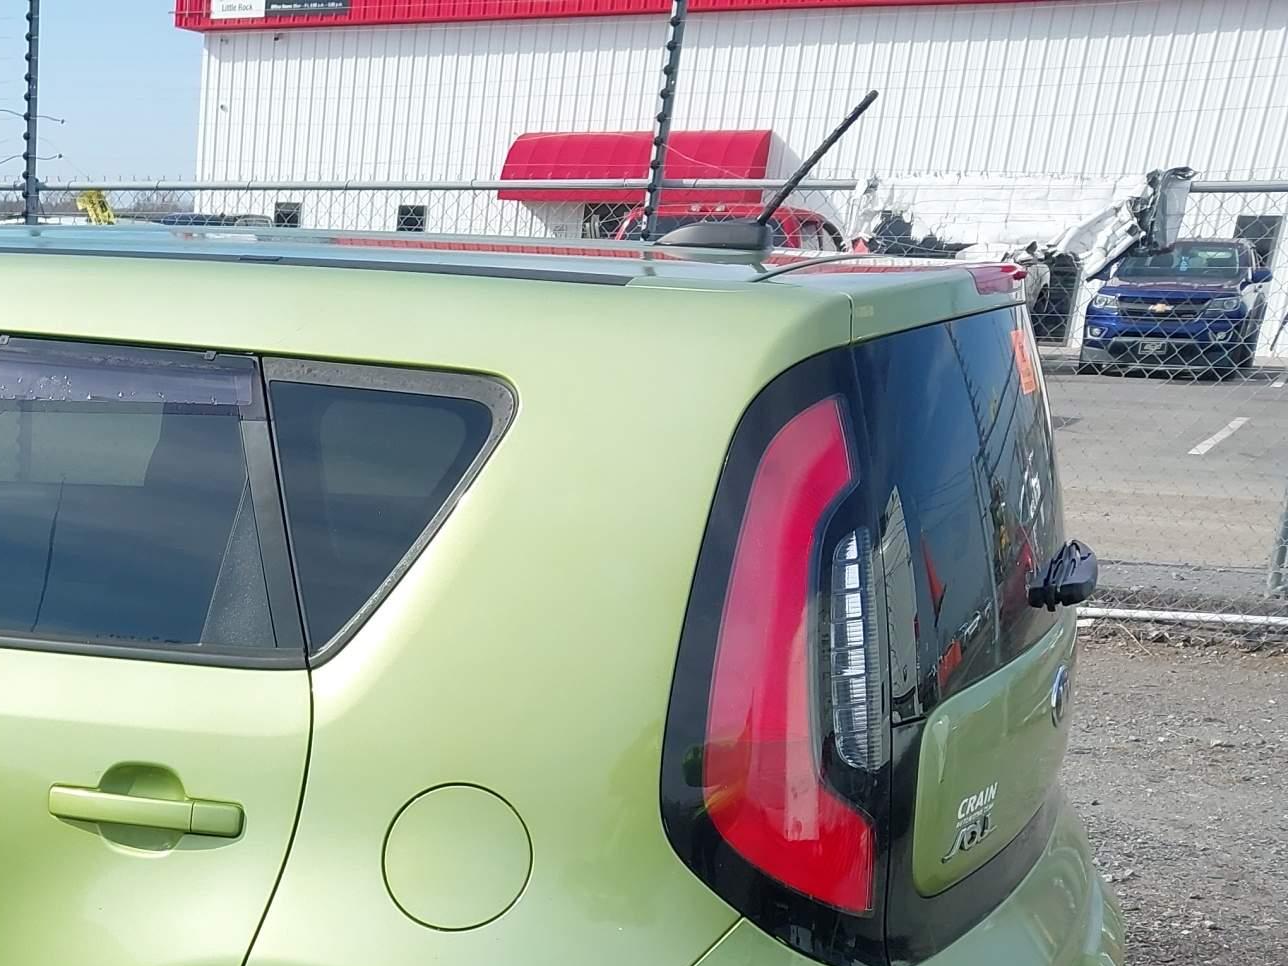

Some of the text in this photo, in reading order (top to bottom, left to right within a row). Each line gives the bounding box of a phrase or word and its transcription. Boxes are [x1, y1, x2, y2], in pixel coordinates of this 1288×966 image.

[221, 2, 253, 12] Little Rock
[957, 781, 999, 820] CRAIN
